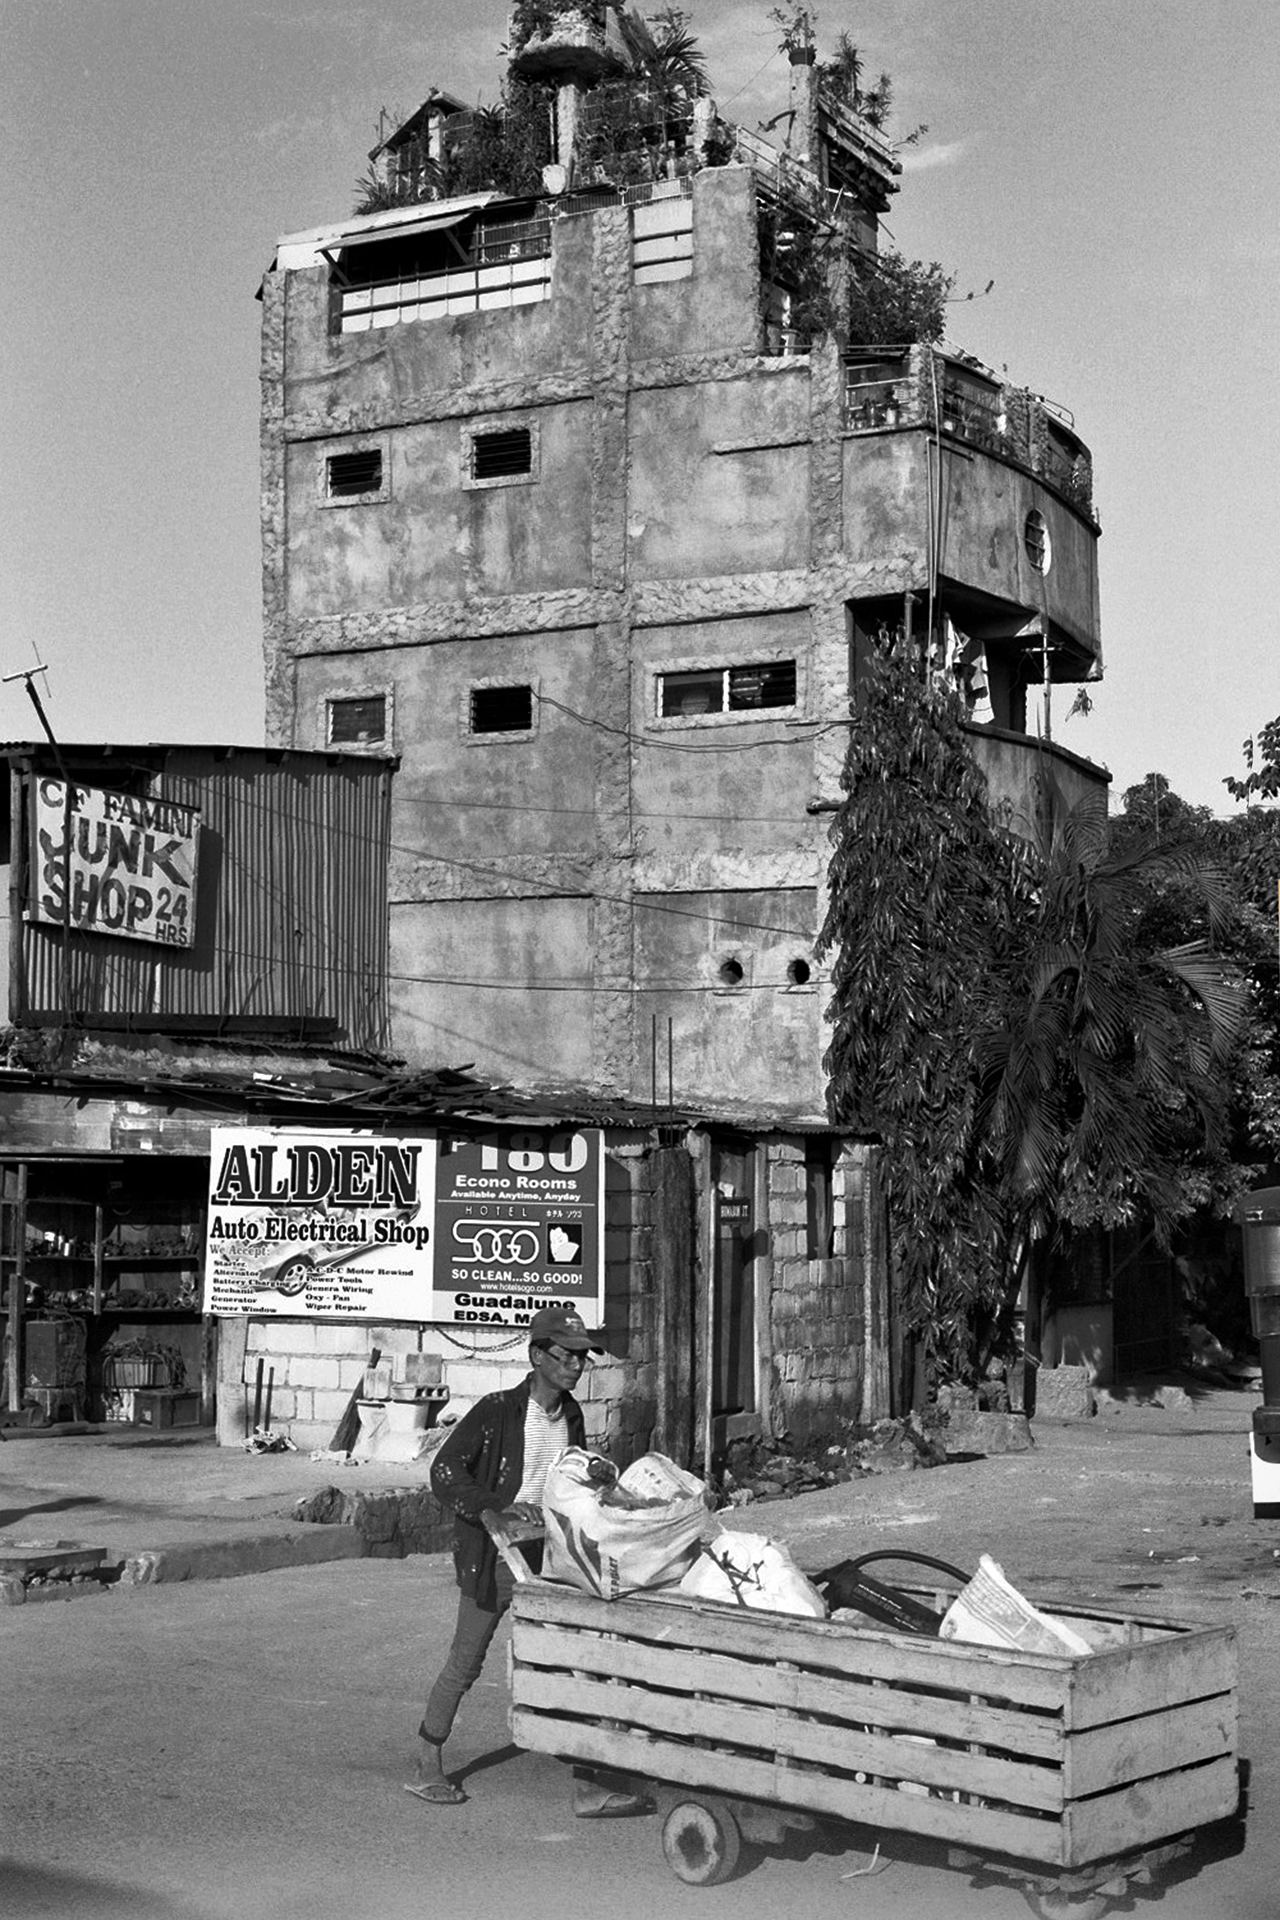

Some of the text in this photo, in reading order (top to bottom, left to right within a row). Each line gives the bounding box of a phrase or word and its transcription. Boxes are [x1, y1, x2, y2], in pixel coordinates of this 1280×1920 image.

[39, 816, 191, 889] JUNK
[42, 860, 188, 931] SHOP 24
[154, 921, 188, 946] HRS
[211, 1145, 422, 1208] ALDEN
[455, 1174, 578, 1190] Econo Rooms
[450, 1190, 581, 1202] Available Anytime, Anyday
[465, 1206, 527, 1217] HOTEL
[210, 1216, 429, 1250] Auto Electrical Shop
[452, 1218, 541, 1265] SOGO
[210, 1244, 271, 1259] We Accept:
[213, 1269, 259, 1277] Alternator
[346, 1267, 375, 1275] Motor
[306, 1275, 363, 1284] Power Tools
[452, 1269, 468, 1280] SO
[543, 1273, 583, 1285] GOOD!
[213, 1278, 290, 1288] Battery Charging
[480, 1282, 553, 1293] www.hotelsogo.com
[213, 1287, 254, 1295] Mechanic
[342, 1286, 373, 1294] Wiring
[211, 1295, 257, 1303] Generator
[305, 1293, 323, 1301] Oxy
[335, 1304, 367, 1312] Repair
[454, 1310, 508, 1325] EDSA,
